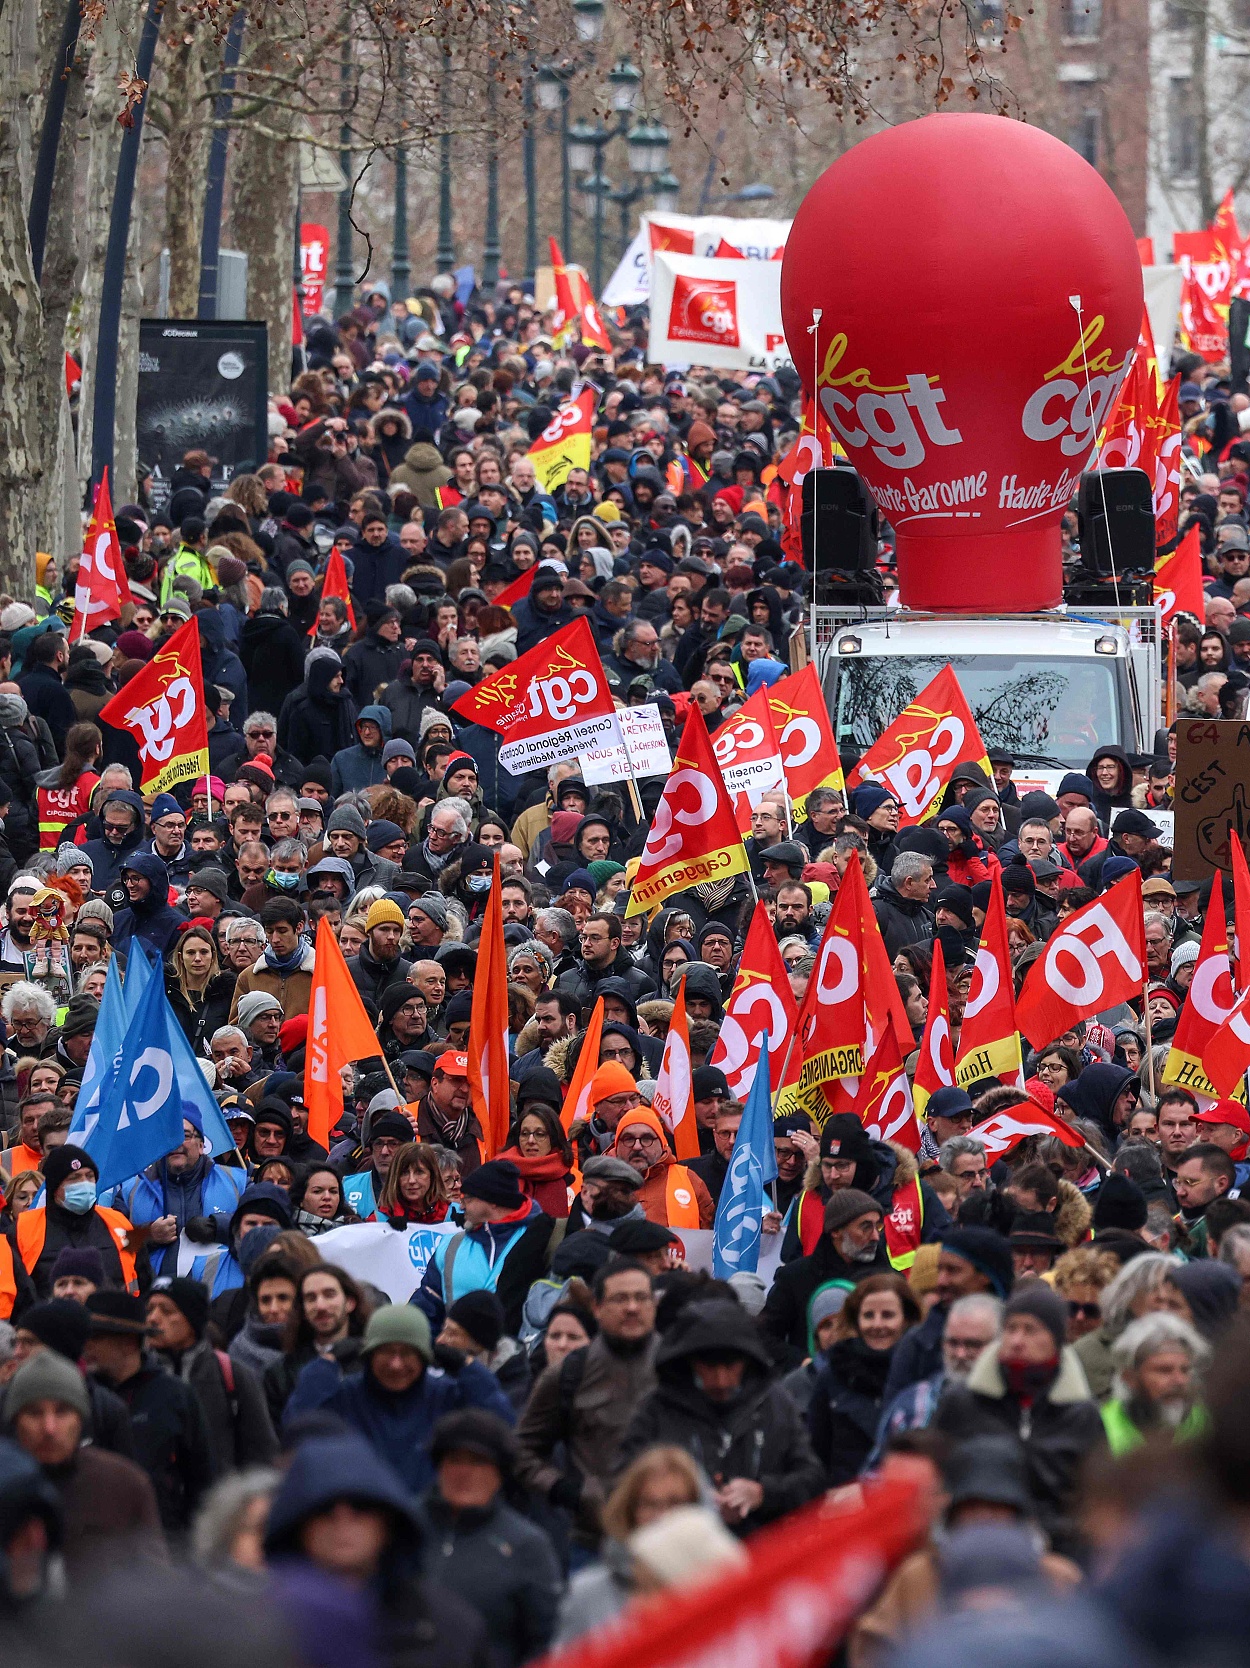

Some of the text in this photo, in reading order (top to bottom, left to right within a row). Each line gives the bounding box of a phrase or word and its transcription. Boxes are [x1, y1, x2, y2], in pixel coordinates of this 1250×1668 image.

[700, 310, 735, 334] cgt
[817, 333, 940, 391] la
[820, 374, 963, 469] cgt
[1187, 723, 1221, 746] 64
[587, 748, 613, 761] NOUS
[629, 740, 667, 754] LÂCHERONS
[1181, 760, 1227, 803] C'EST
[47, 786, 80, 808] cgt
[890, 1208, 913, 1225] cgt
